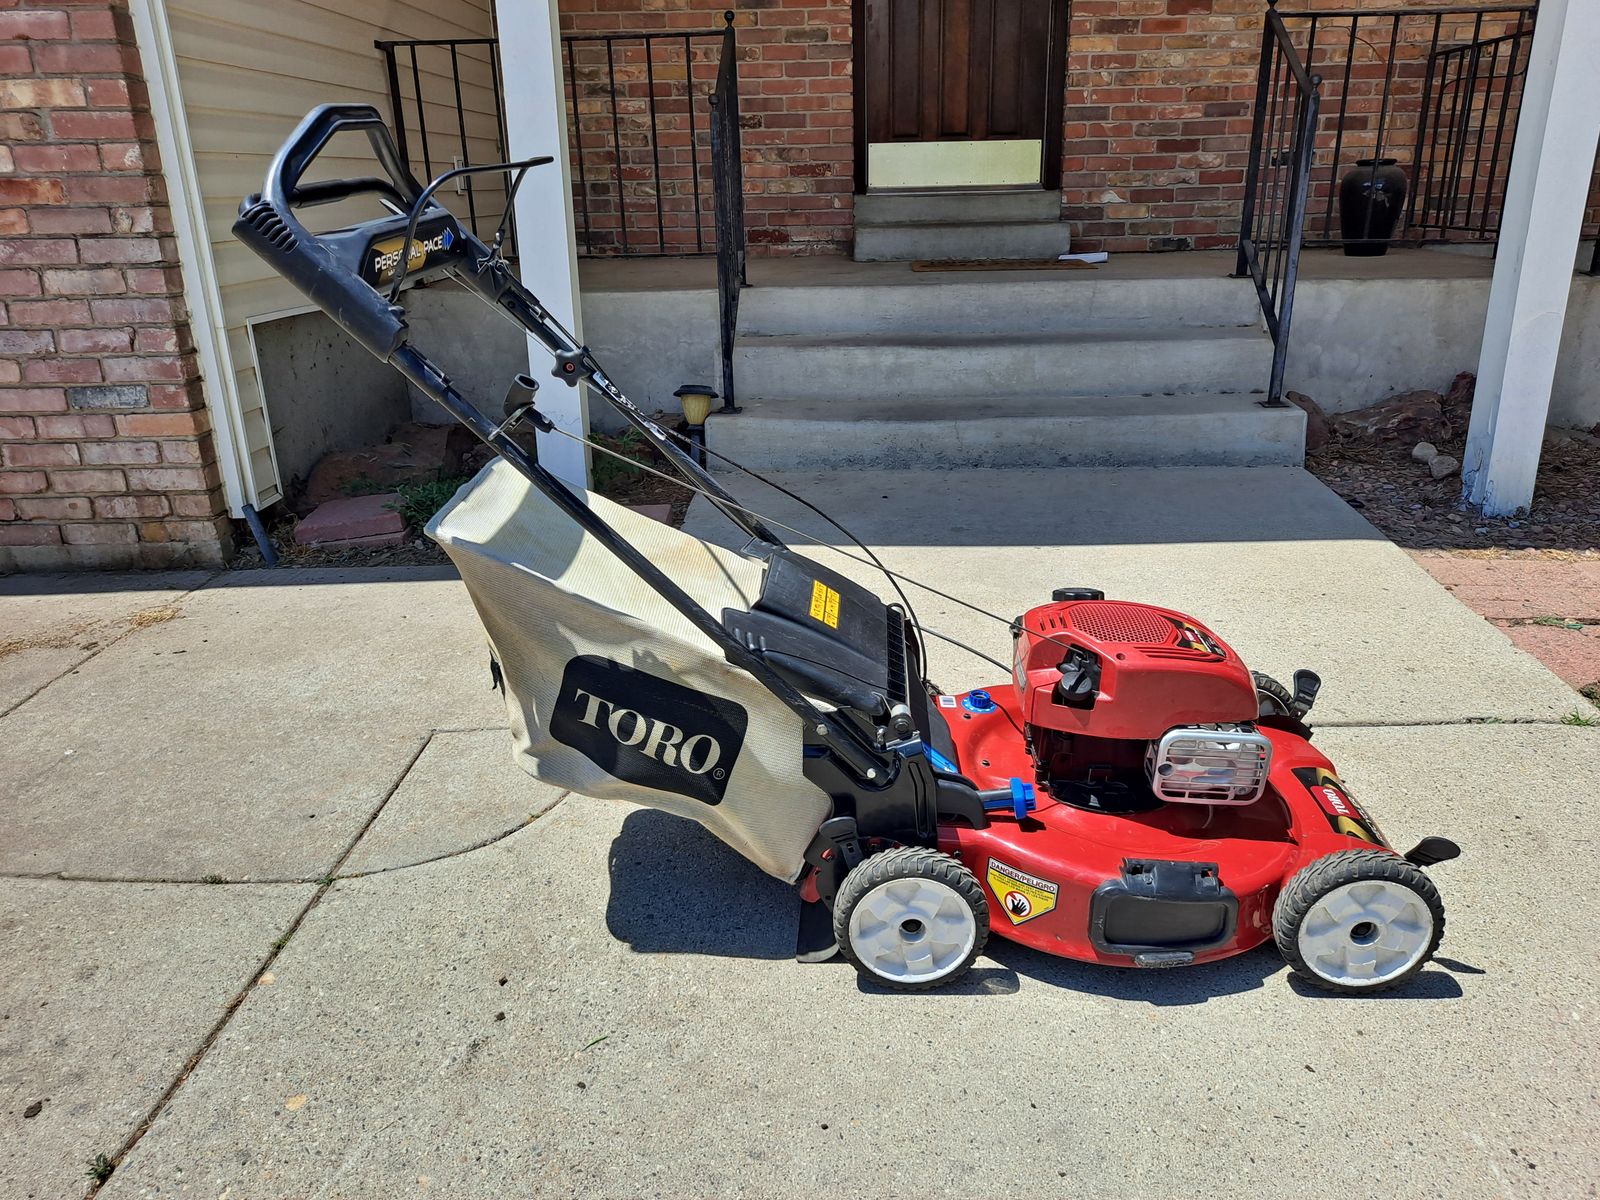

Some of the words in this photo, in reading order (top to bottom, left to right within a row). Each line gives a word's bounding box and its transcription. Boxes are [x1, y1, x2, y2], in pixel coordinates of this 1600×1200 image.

[374, 244, 421, 272] PERSAL
[423, 235, 443, 253] PACE
[574, 688, 721, 775] TORO
